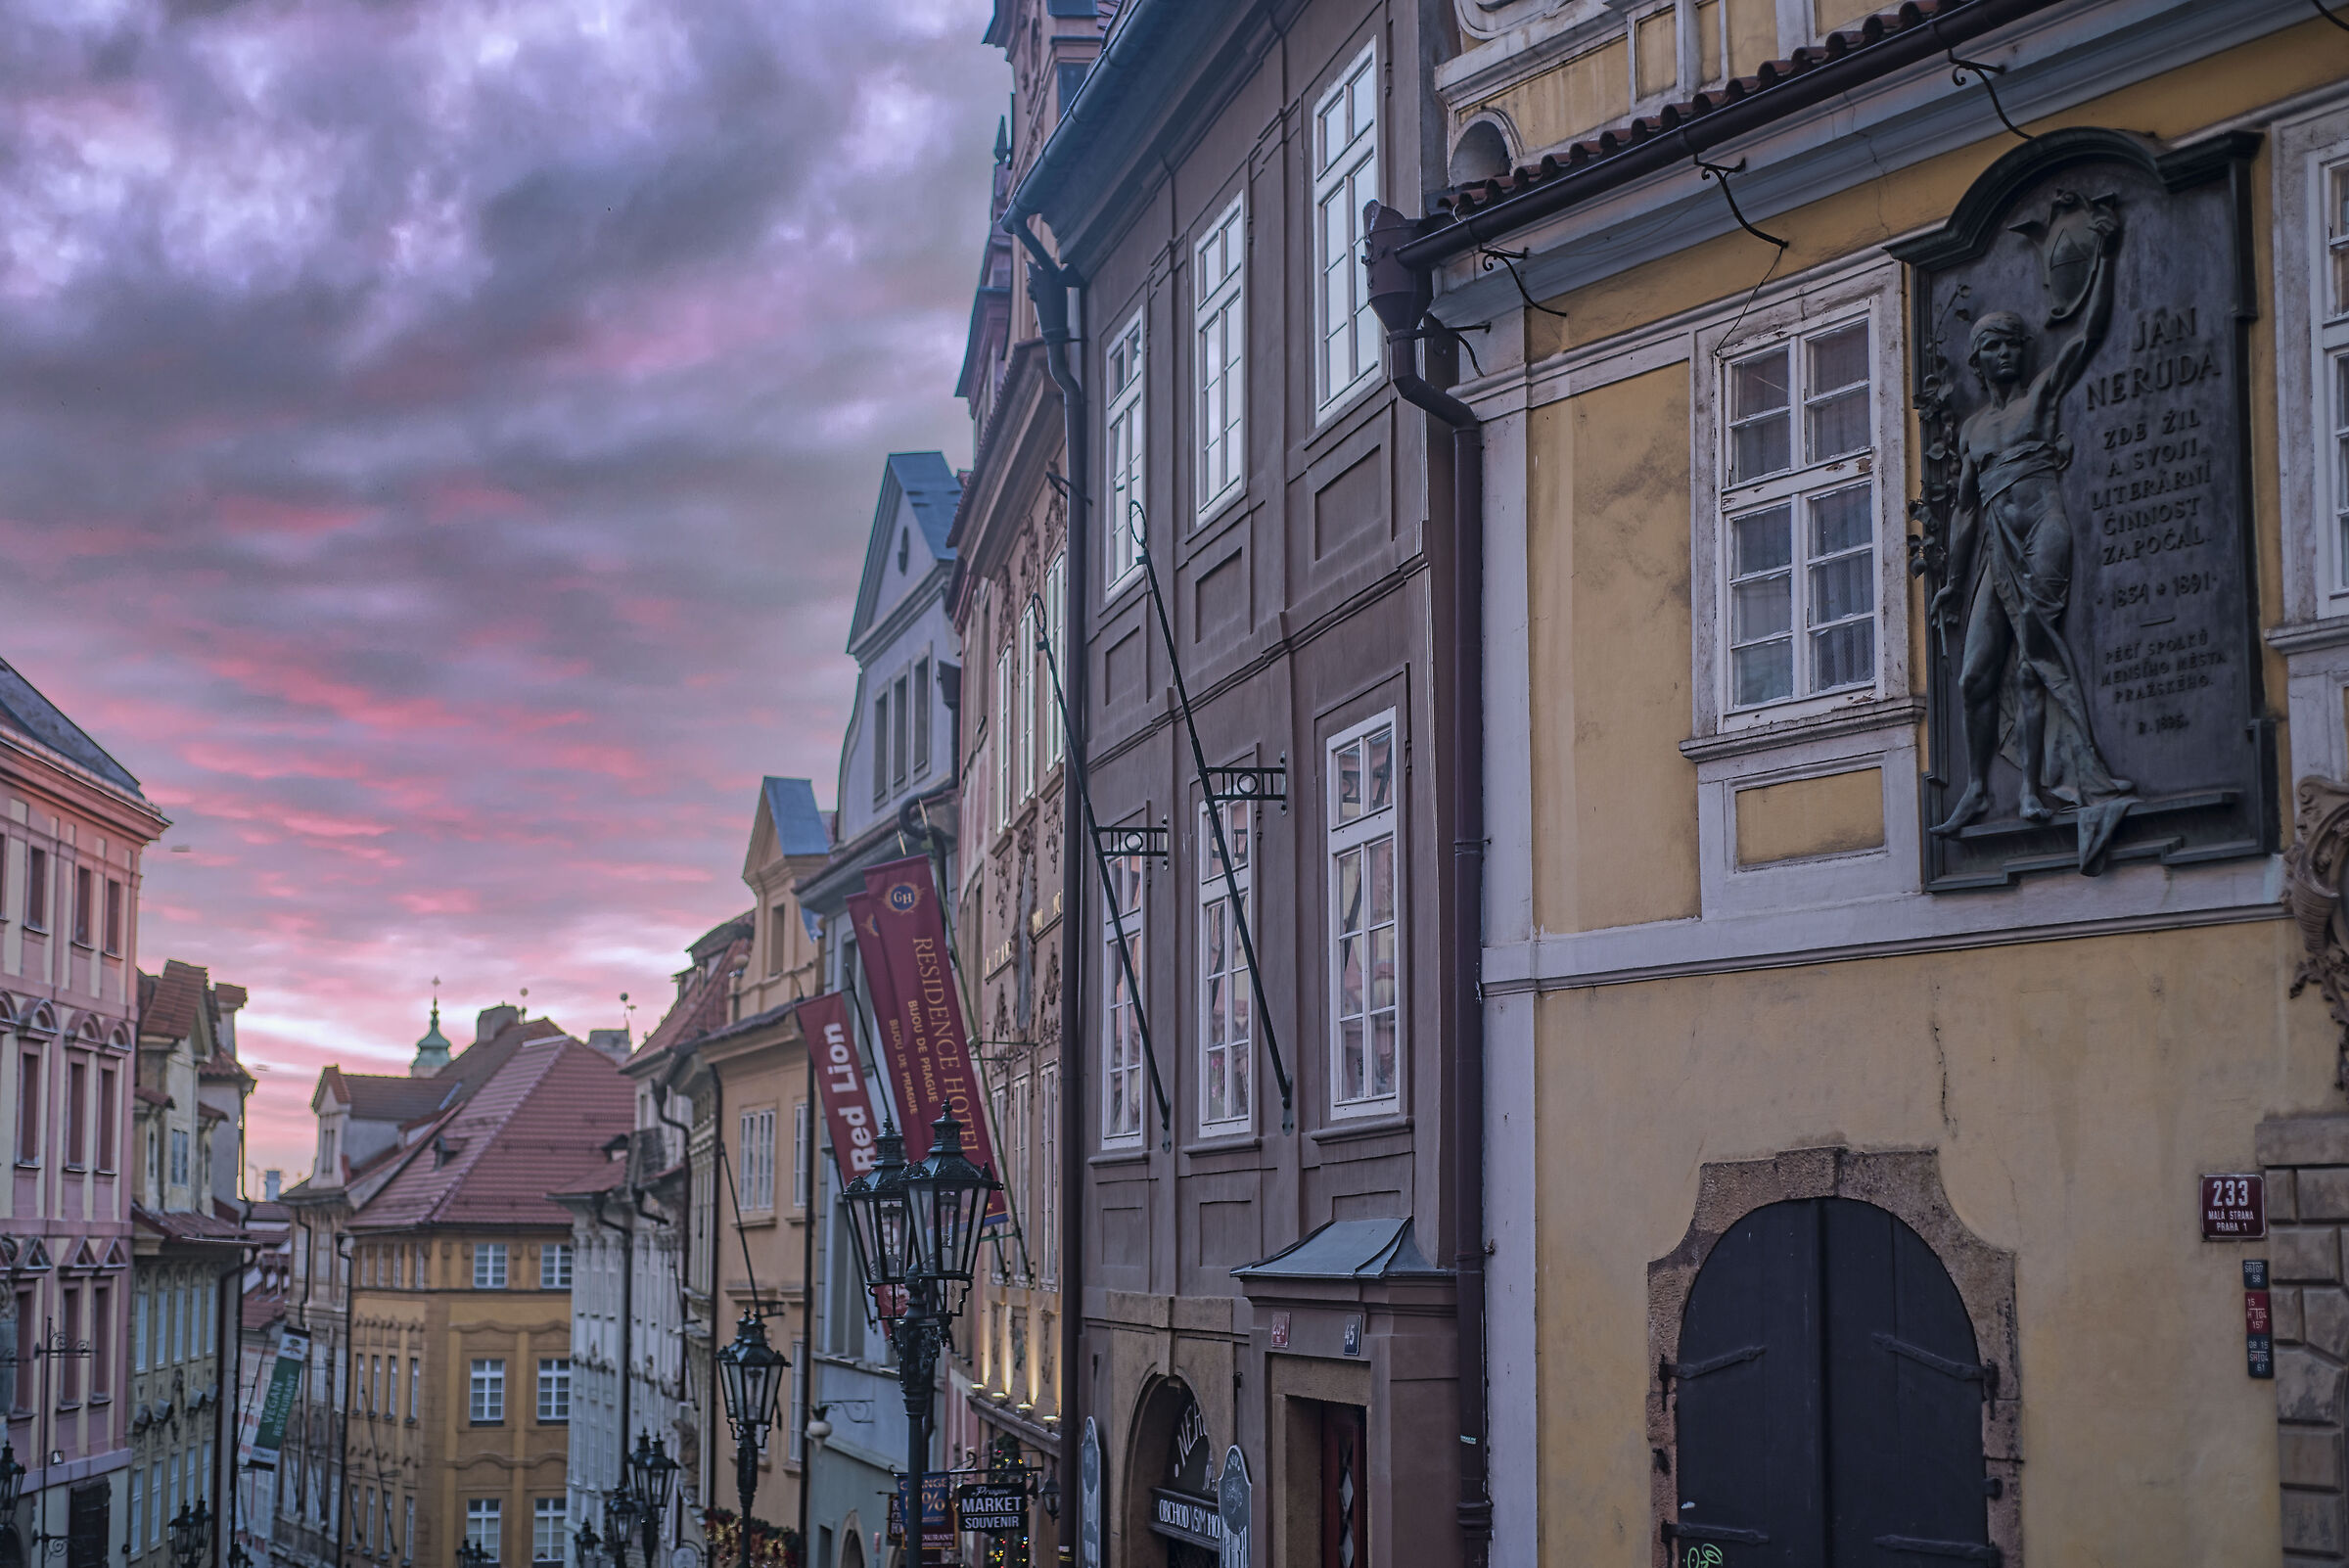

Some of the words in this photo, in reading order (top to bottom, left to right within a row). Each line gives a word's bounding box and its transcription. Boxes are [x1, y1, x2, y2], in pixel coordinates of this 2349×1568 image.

[2132, 307, 2197, 352] JAN
[2086, 350, 2222, 411] NERUDA
[2103, 422, 2147, 450] ZDE
[2107, 458, 2122, 479] A
[2134, 438, 2197, 471] SVOJI
[893, 890, 912, 903] GH
[907, 999, 925, 1034] BIJOU
[912, 937, 961, 1071] RESIDENCE
[888, 1018, 905, 1052] BIJOU
[917, 1037, 928, 1053] DE
[823, 1023, 858, 1092] Lion
[897, 1054, 908, 1070] DE
[900, 1072, 918, 1115] PRAGUE
[919, 1057, 939, 1103] PRAGUE
[838, 1107, 877, 1173] Red
[2213, 1180, 2249, 1206] 233
[2208, 1209, 2226, 1220] MALÁ
[2230, 1210, 2254, 1221] STRANA
[2216, 1222, 2239, 1232] PRAHA
[2242, 1222, 2248, 1231] 1
[1344, 1323, 1356, 1345] 45
[263, 1380, 284, 1423] VEGAN
[899, 1478, 947, 1491] CNGE
[961, 1497, 1023, 1513] MARKET
[964, 1516, 1019, 1529] SOUVENIR
